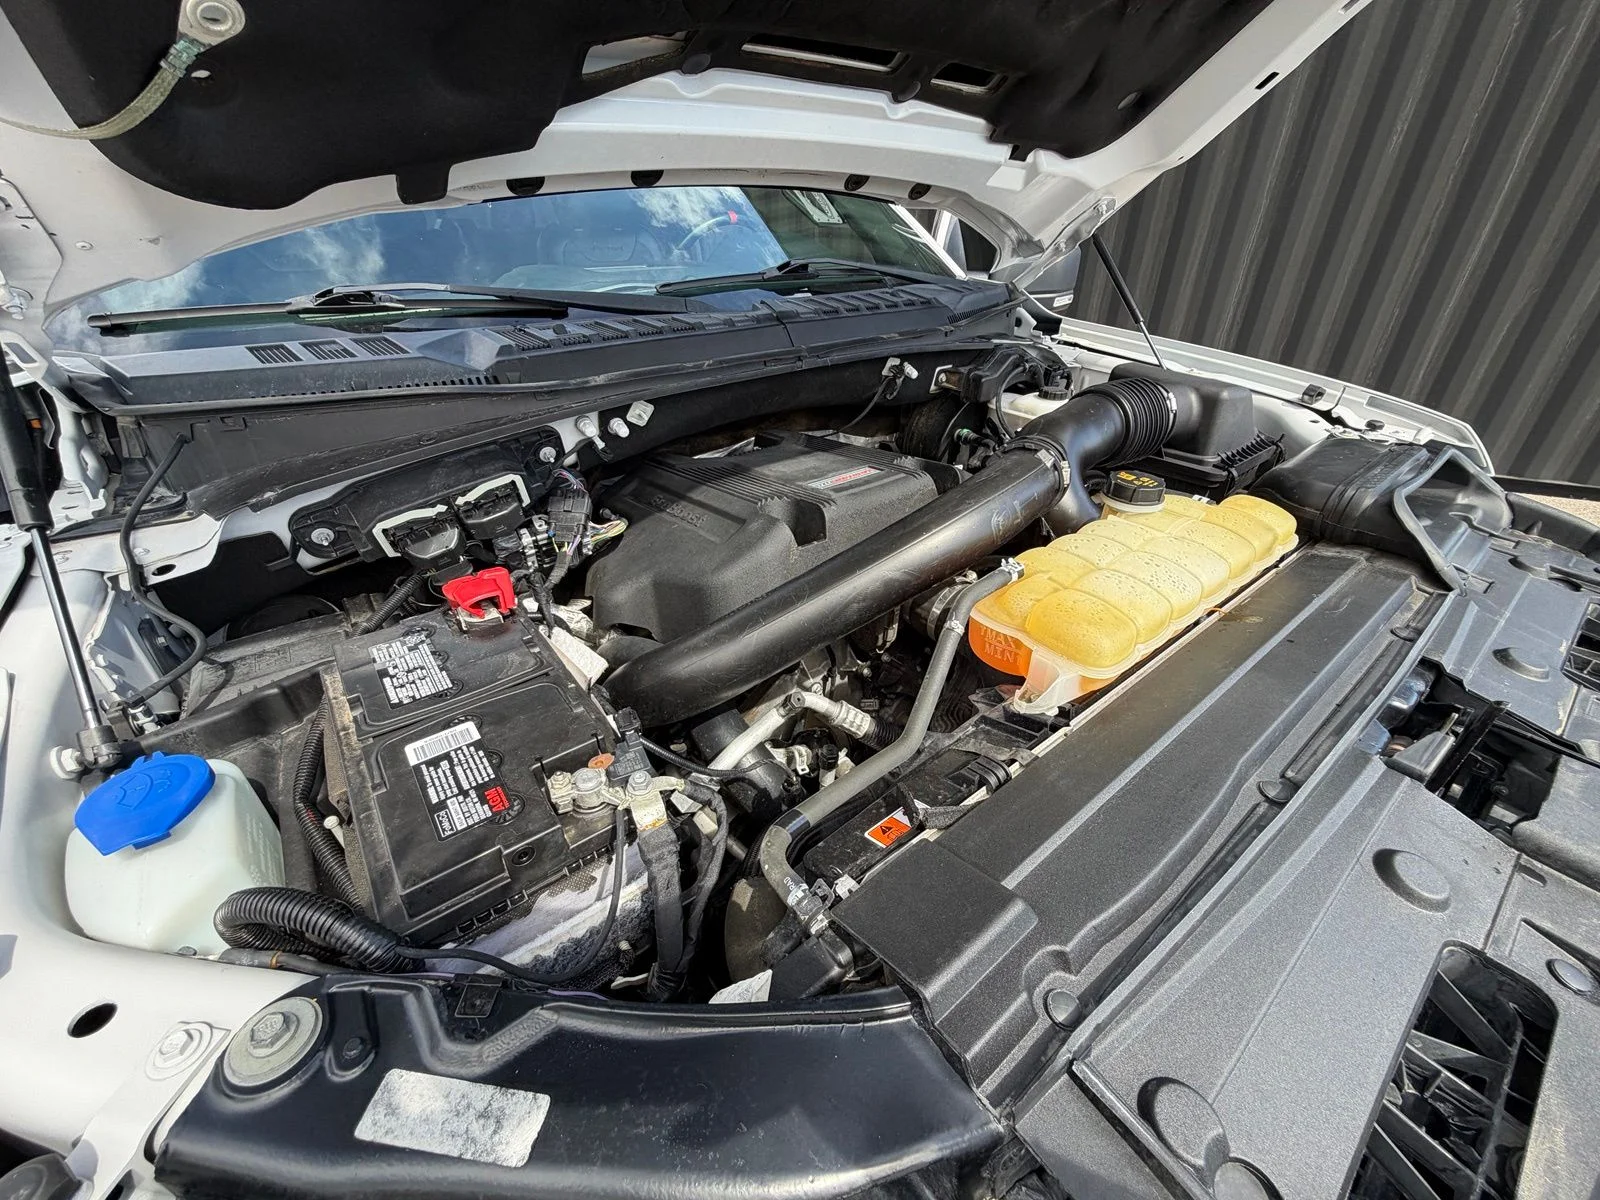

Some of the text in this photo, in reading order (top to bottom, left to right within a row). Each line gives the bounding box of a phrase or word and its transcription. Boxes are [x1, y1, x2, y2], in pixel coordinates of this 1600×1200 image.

[985, 642, 1015, 662] MIN
[485, 787, 505, 812] AGM
[438, 811, 454, 834] FoMoCo
[783, 876, 795, 891] RAD
